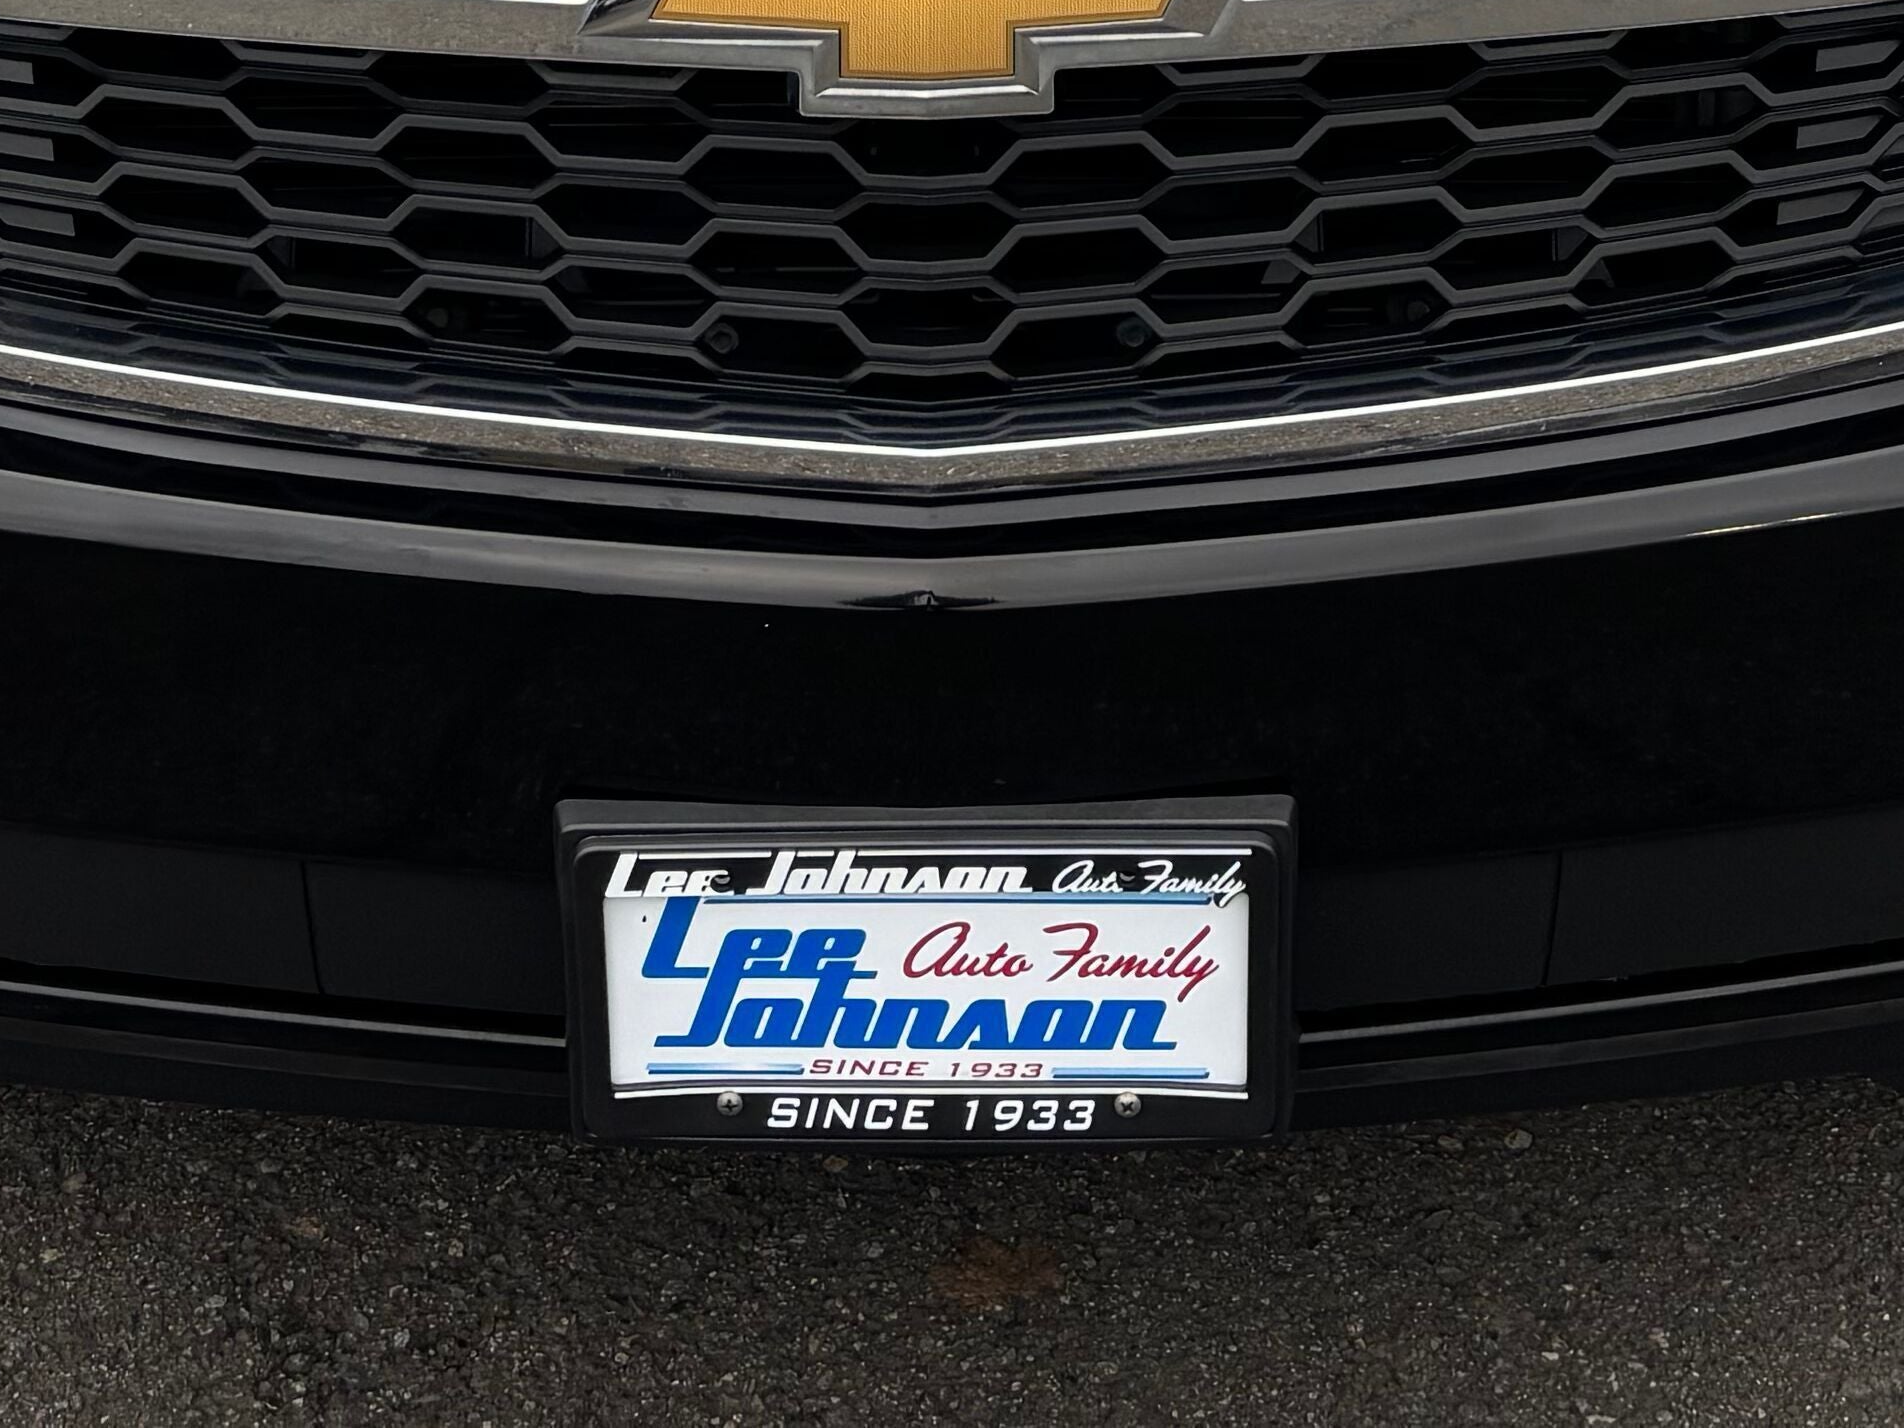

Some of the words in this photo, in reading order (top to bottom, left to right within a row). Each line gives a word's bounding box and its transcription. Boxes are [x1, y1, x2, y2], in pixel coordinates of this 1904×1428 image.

[745, 849, 1033, 897] Johnson
[1137, 859, 1247, 908] Family
[641, 896, 879, 980] Lee
[902, 921, 1034, 978] Auto
[1042, 922, 1220, 1004] Family
[653, 972, 1178, 1051] Johnson
[809, 1058, 929, 1077] SINCE
[950, 1061, 1044, 1079] 1933
[767, 1097, 935, 1131] SINCE
[964, 1099, 1096, 1132] 1933
